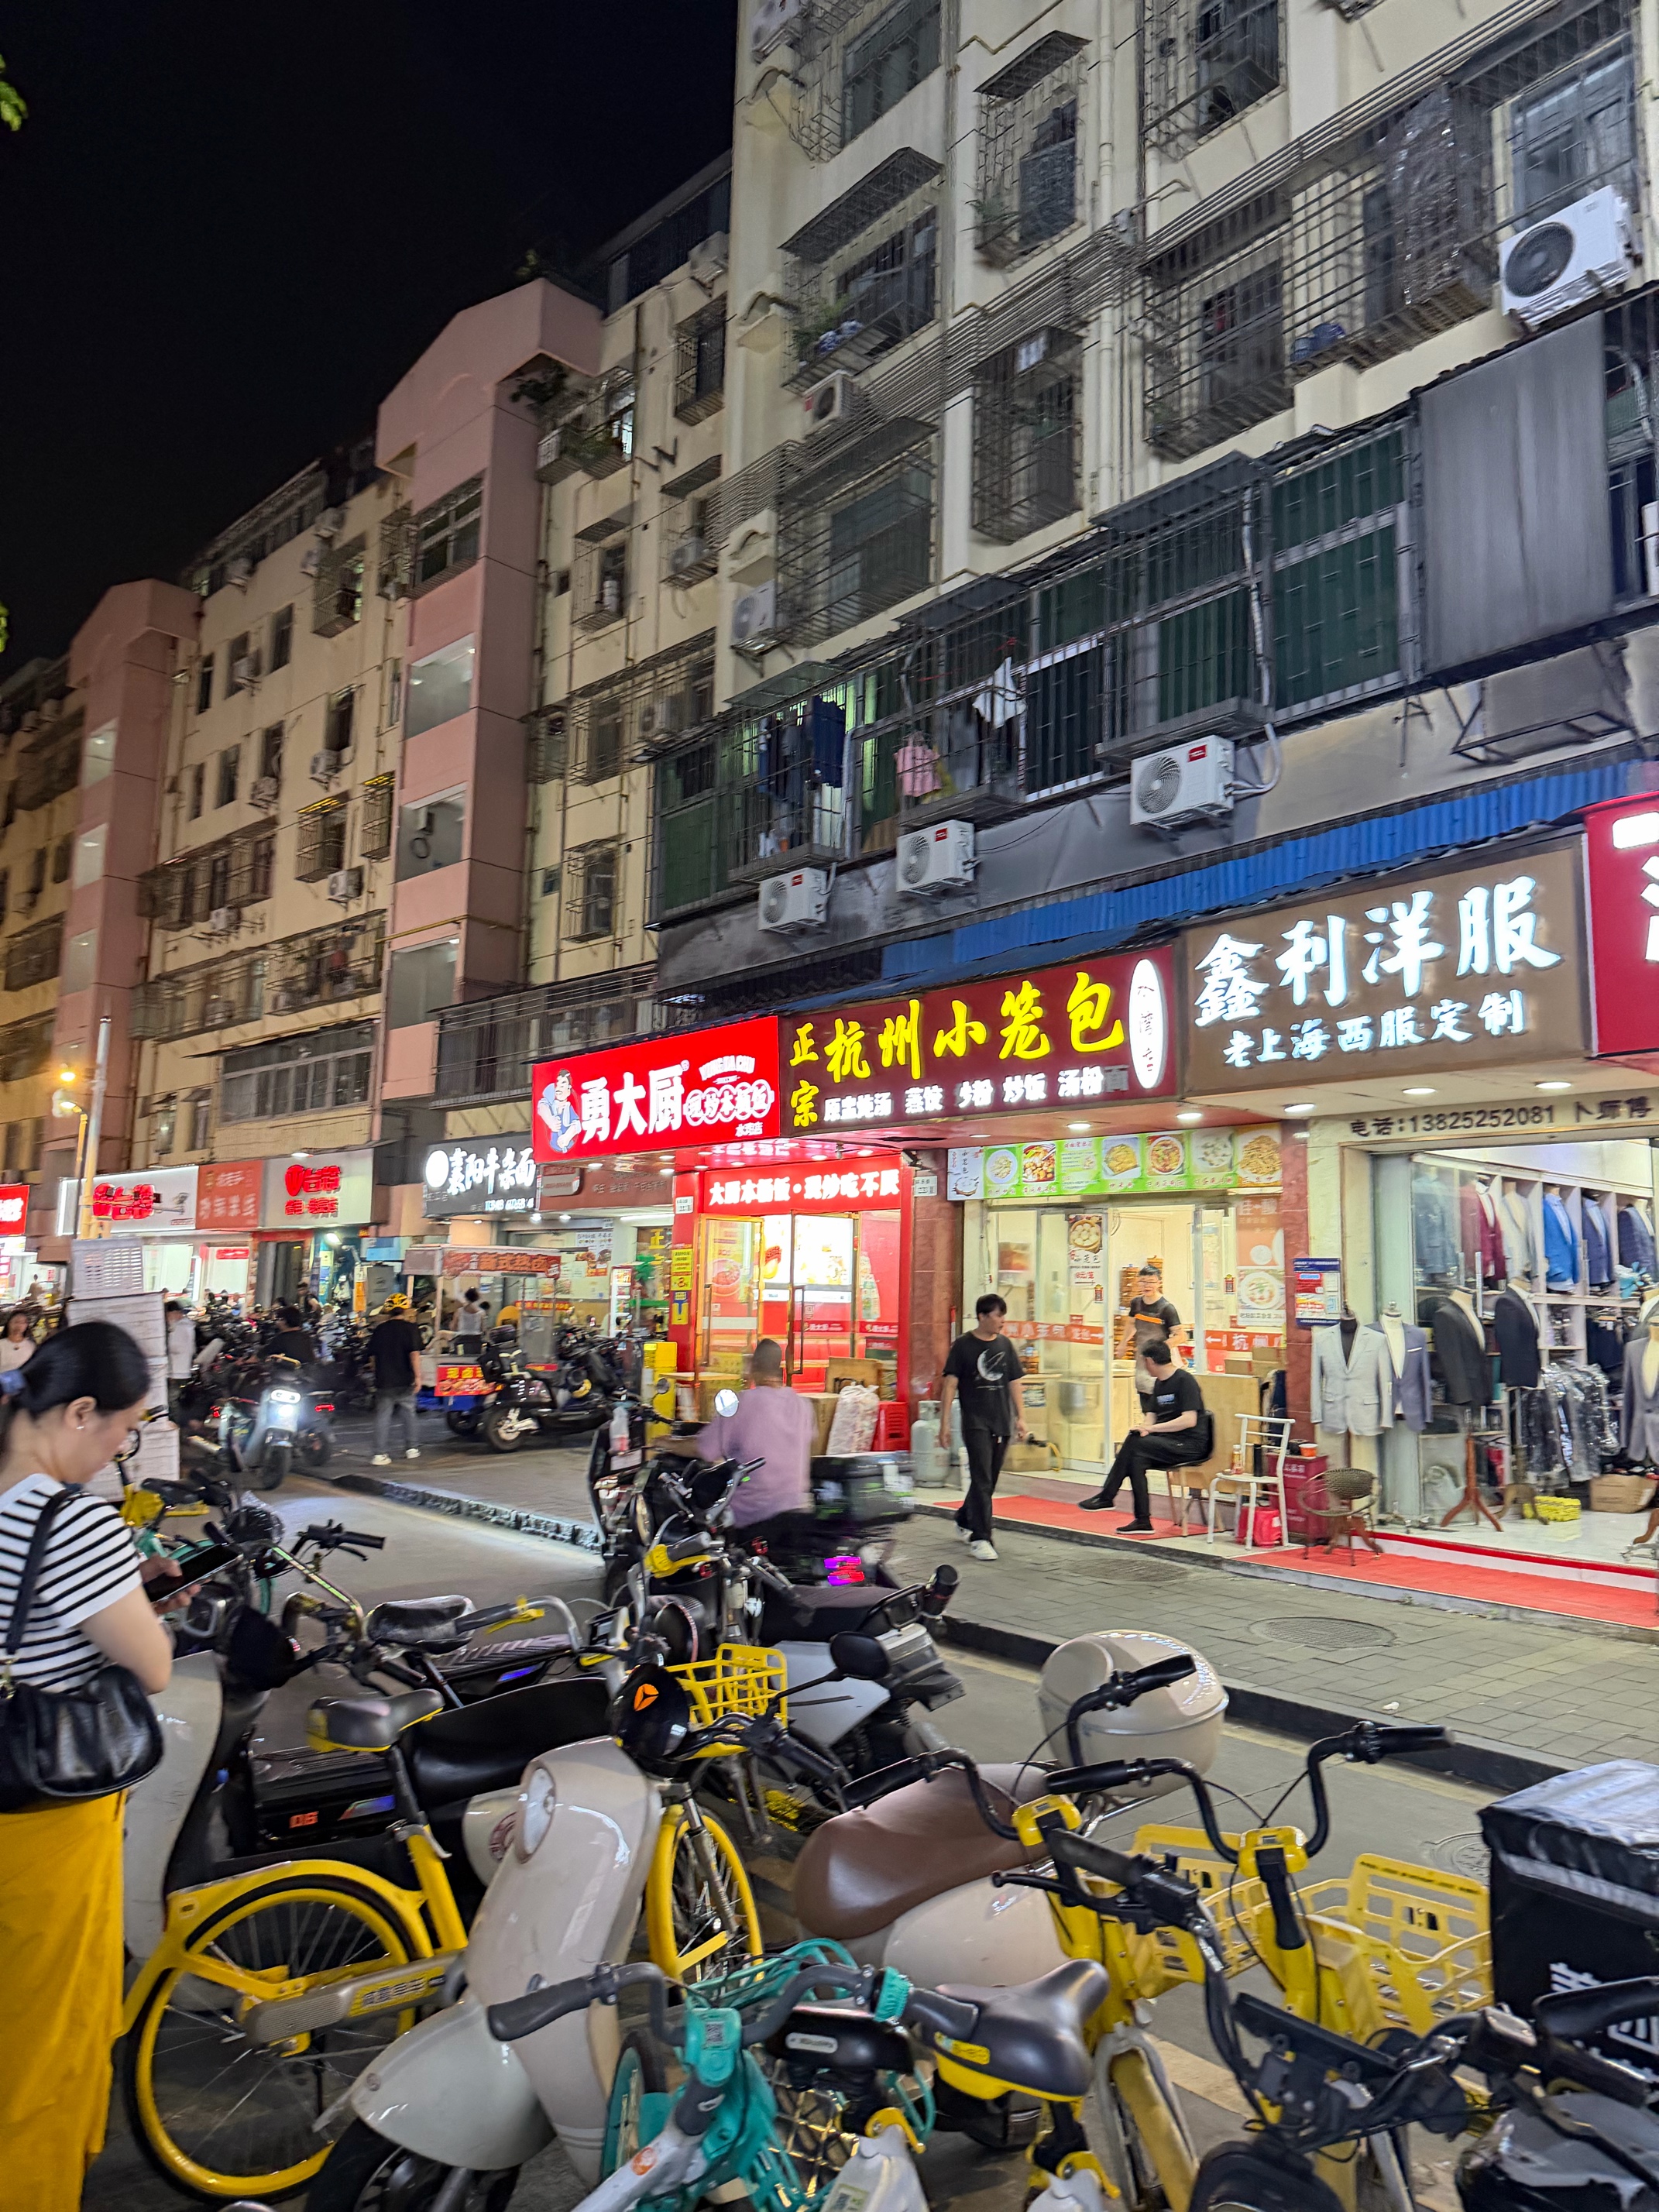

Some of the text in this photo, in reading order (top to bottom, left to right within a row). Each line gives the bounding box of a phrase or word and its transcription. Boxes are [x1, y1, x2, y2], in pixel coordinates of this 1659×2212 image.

[1195, 876, 1561, 1026] 鑫利洋服
[824, 972, 1125, 1082] 杭州小笼包
[1224, 990, 1524, 1067] 老上海西服定制
[581, 1063, 685, 1145] 勇大厨
[789, 1022, 819, 1127] 正宗
[1003, 1073, 1046, 1103] 炒饭
